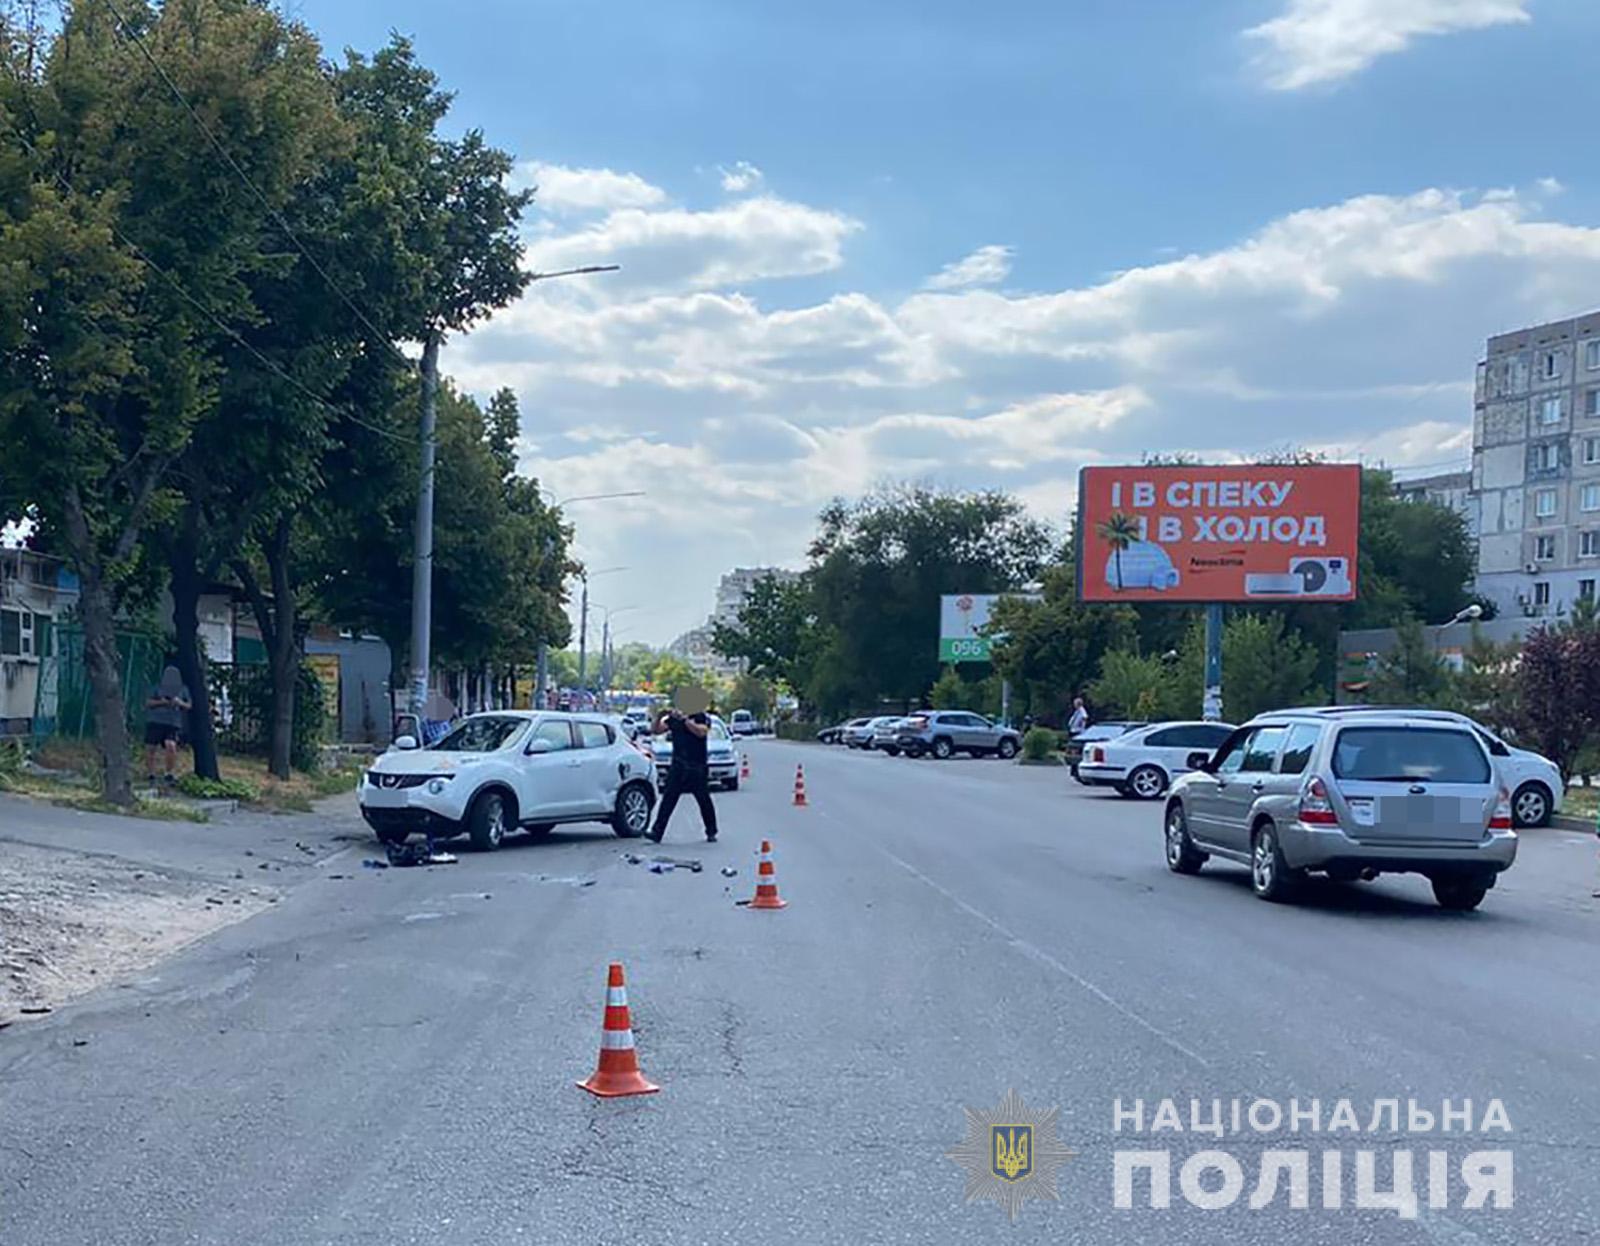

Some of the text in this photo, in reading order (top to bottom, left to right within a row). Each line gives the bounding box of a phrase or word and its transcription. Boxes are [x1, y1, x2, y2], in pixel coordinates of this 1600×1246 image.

[1112, 481, 1293, 507] І В СПЕКУ
[1159, 516, 1183, 542] В
[1192, 515, 1326, 546] ХОЛОД
